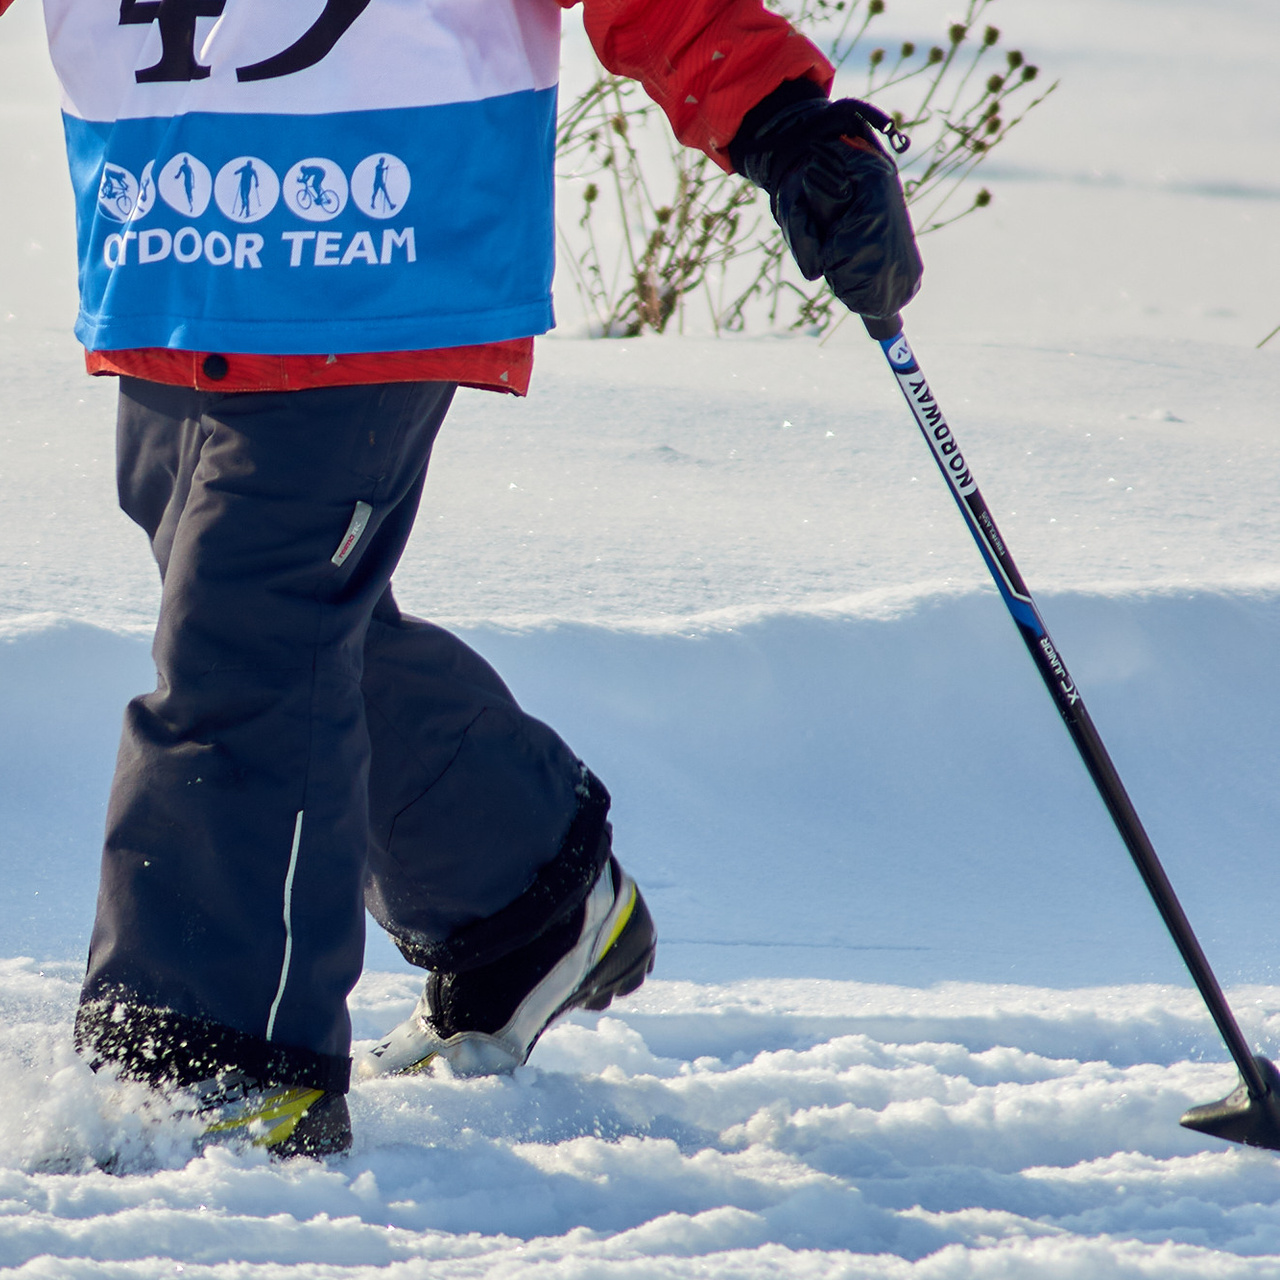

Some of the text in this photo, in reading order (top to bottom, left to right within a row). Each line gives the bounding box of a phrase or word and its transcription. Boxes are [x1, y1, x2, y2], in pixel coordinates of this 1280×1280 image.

[104, 226, 417, 269] OTDOOR TEAM
[909, 378, 974, 488] NORDWAY
[1040, 636, 1066, 678] JUNIOR
